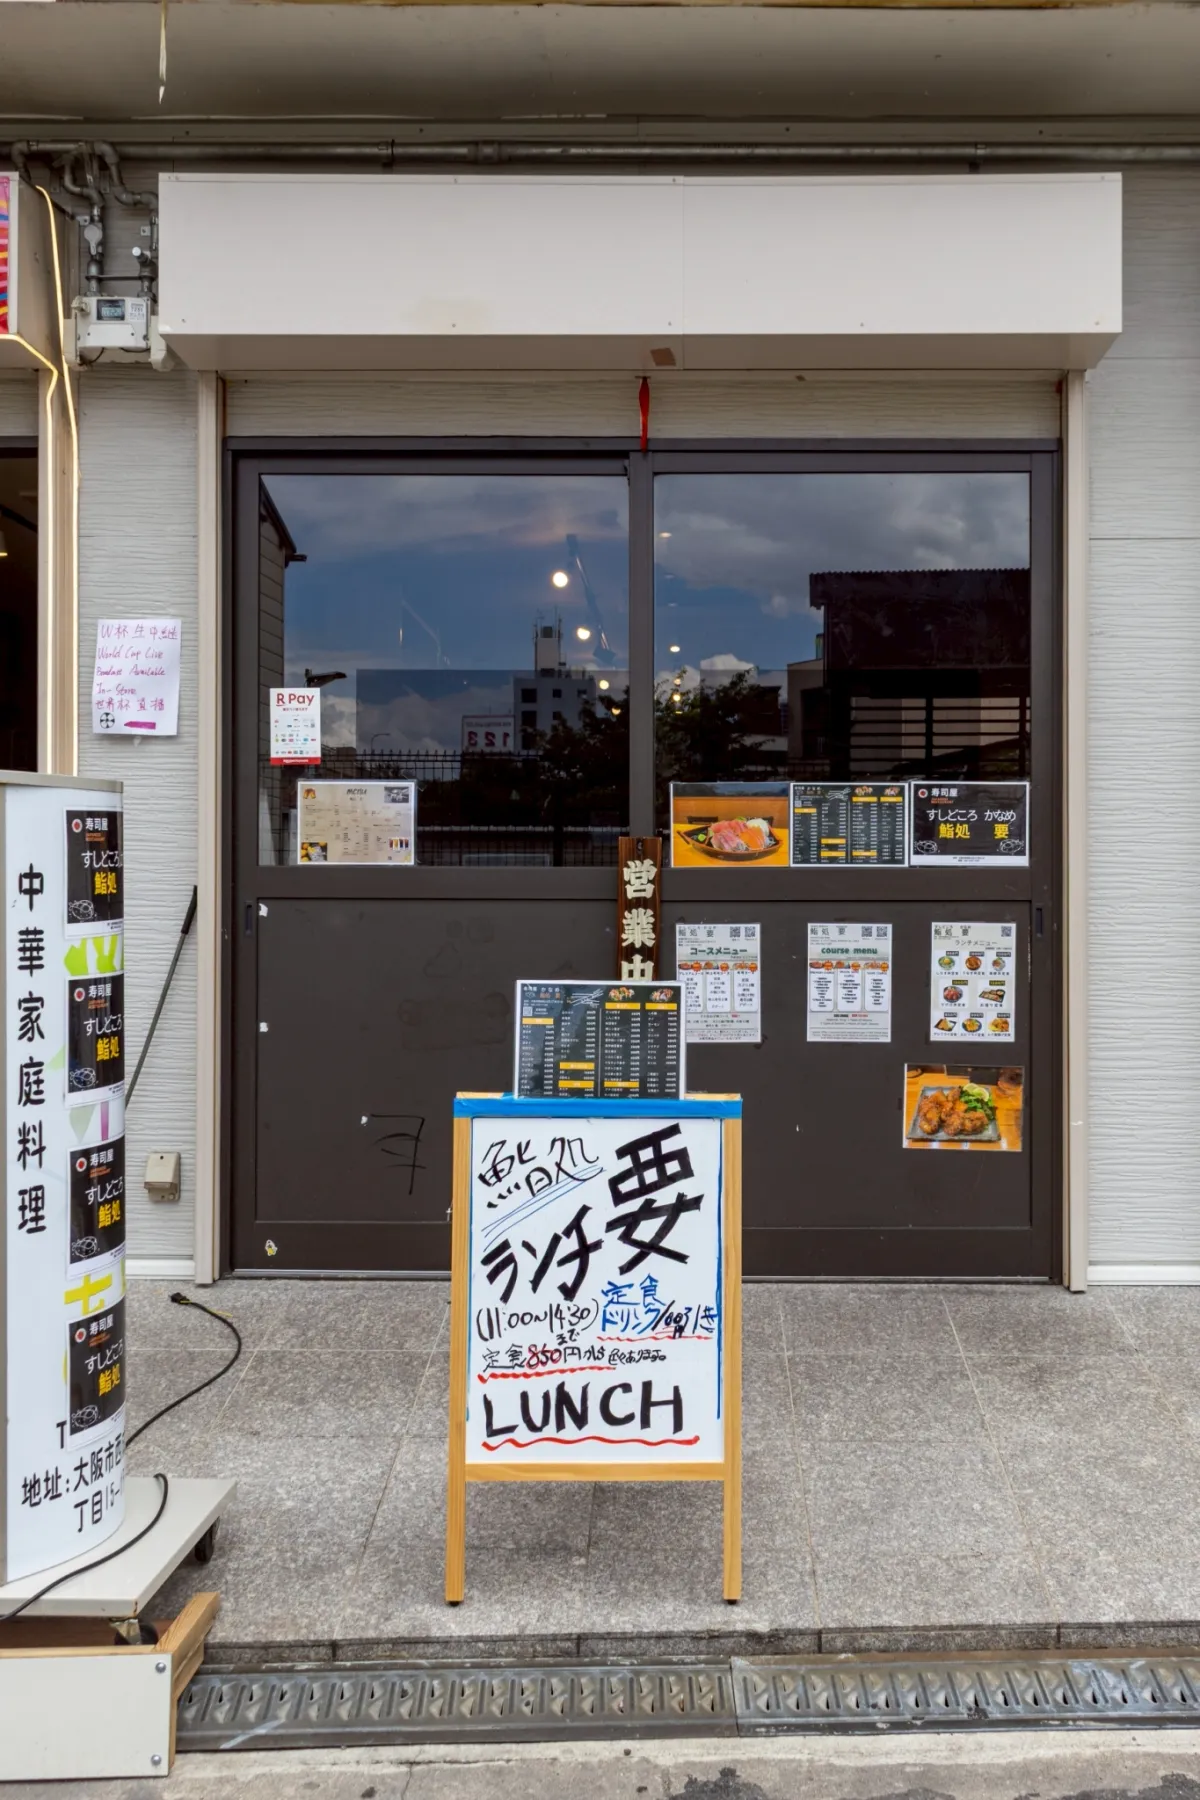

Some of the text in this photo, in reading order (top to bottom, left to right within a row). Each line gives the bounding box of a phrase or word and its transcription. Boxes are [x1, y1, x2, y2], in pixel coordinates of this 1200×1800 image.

[145, 646, 164, 659] Live
[288, 693, 314, 706] Pay
[85, 818, 109, 831] 寿司屋
[926, 809, 1017, 822] すしどころ かなめ
[939, 823, 1009, 840] 鮨処 要
[94, 871, 117, 895] 鮨処
[690, 947, 747, 955] コースメニュー
[821, 947, 878, 955] course menu
[88, 982, 112, 1001] 寿司屋
[17, 863, 46, 1232] 中華家庭料理
[96, 1035, 119, 1062] 鮨処
[90, 1148, 114, 1167] 寿司屋
[605, 1122, 705, 1275] 要
[480, 1203, 604, 1304] ランチ
[600, 1273, 667, 1307] 定食
[482, 1379, 684, 1437] LUNCH
